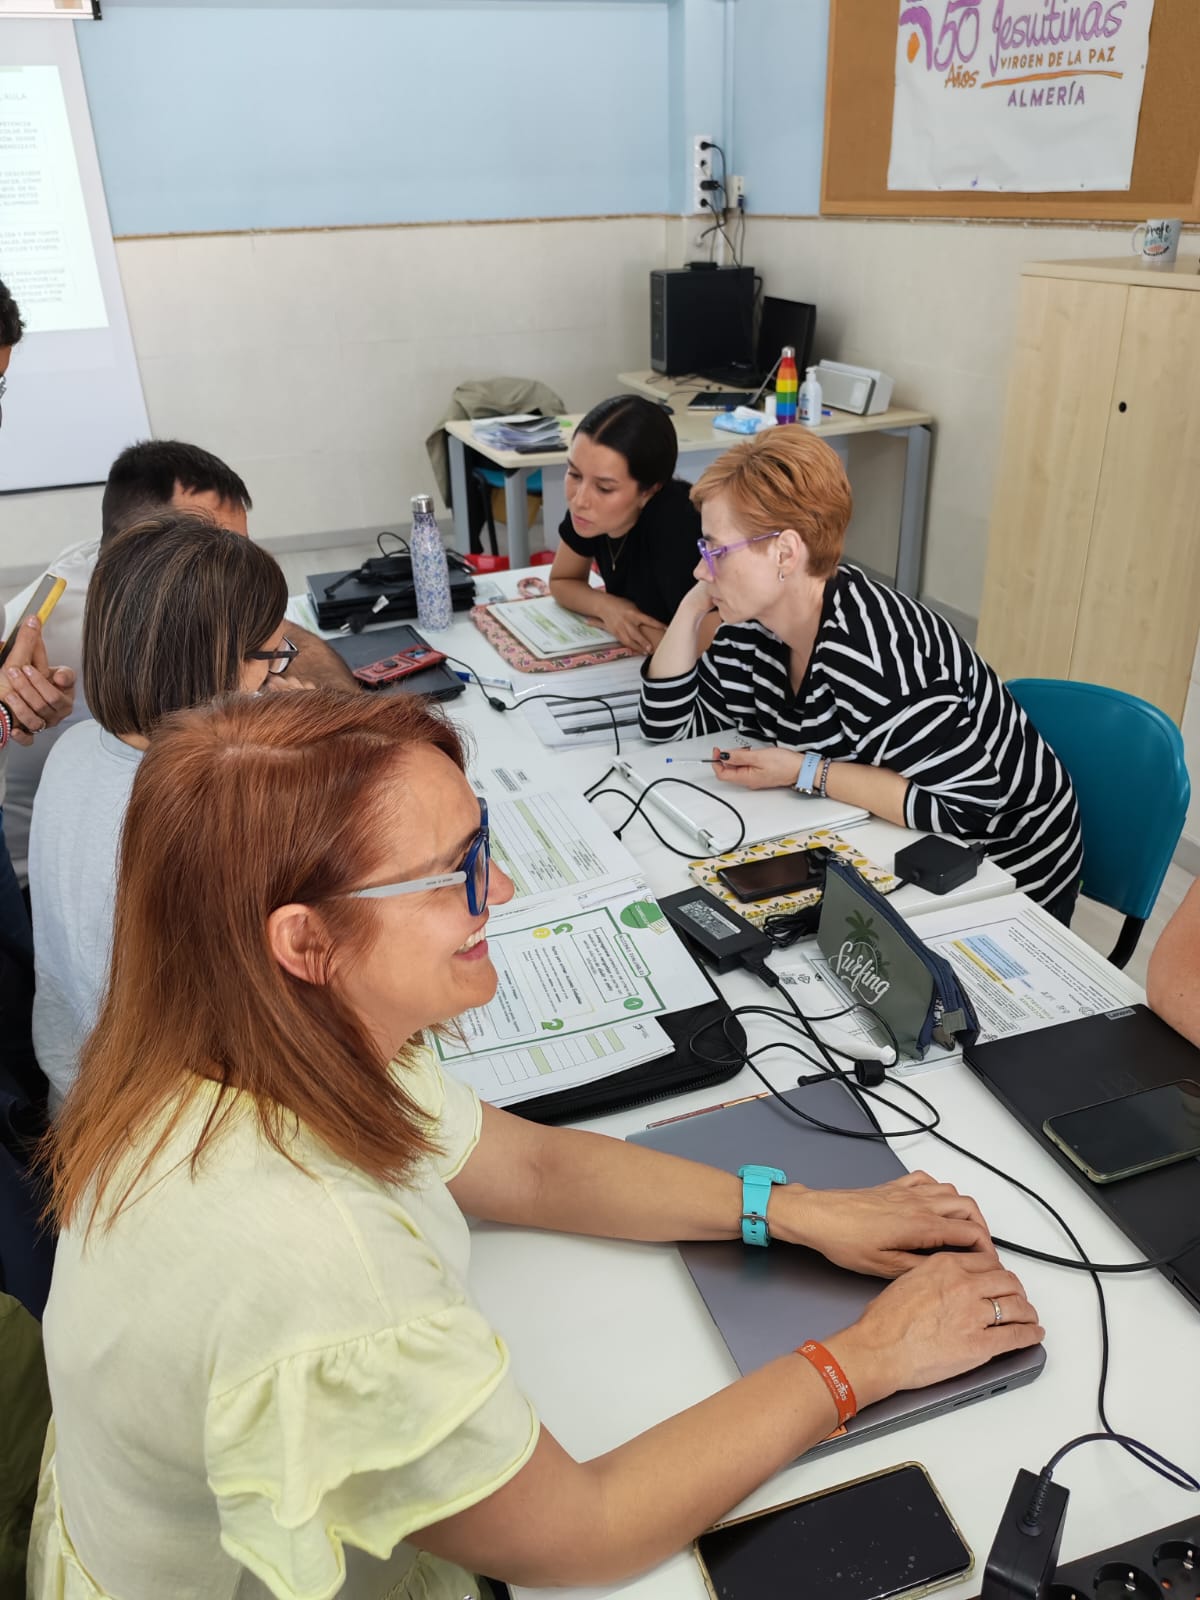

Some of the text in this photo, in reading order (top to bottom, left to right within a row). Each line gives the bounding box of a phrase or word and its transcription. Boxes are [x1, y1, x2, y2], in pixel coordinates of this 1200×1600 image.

[1001, 46, 1116, 71] VIRGEN DE LA PAZ
[944, 63, 980, 89] Años
[1007, 81, 1086, 107] ALMERÍA
[830, 941, 890, 1004] Surfing
